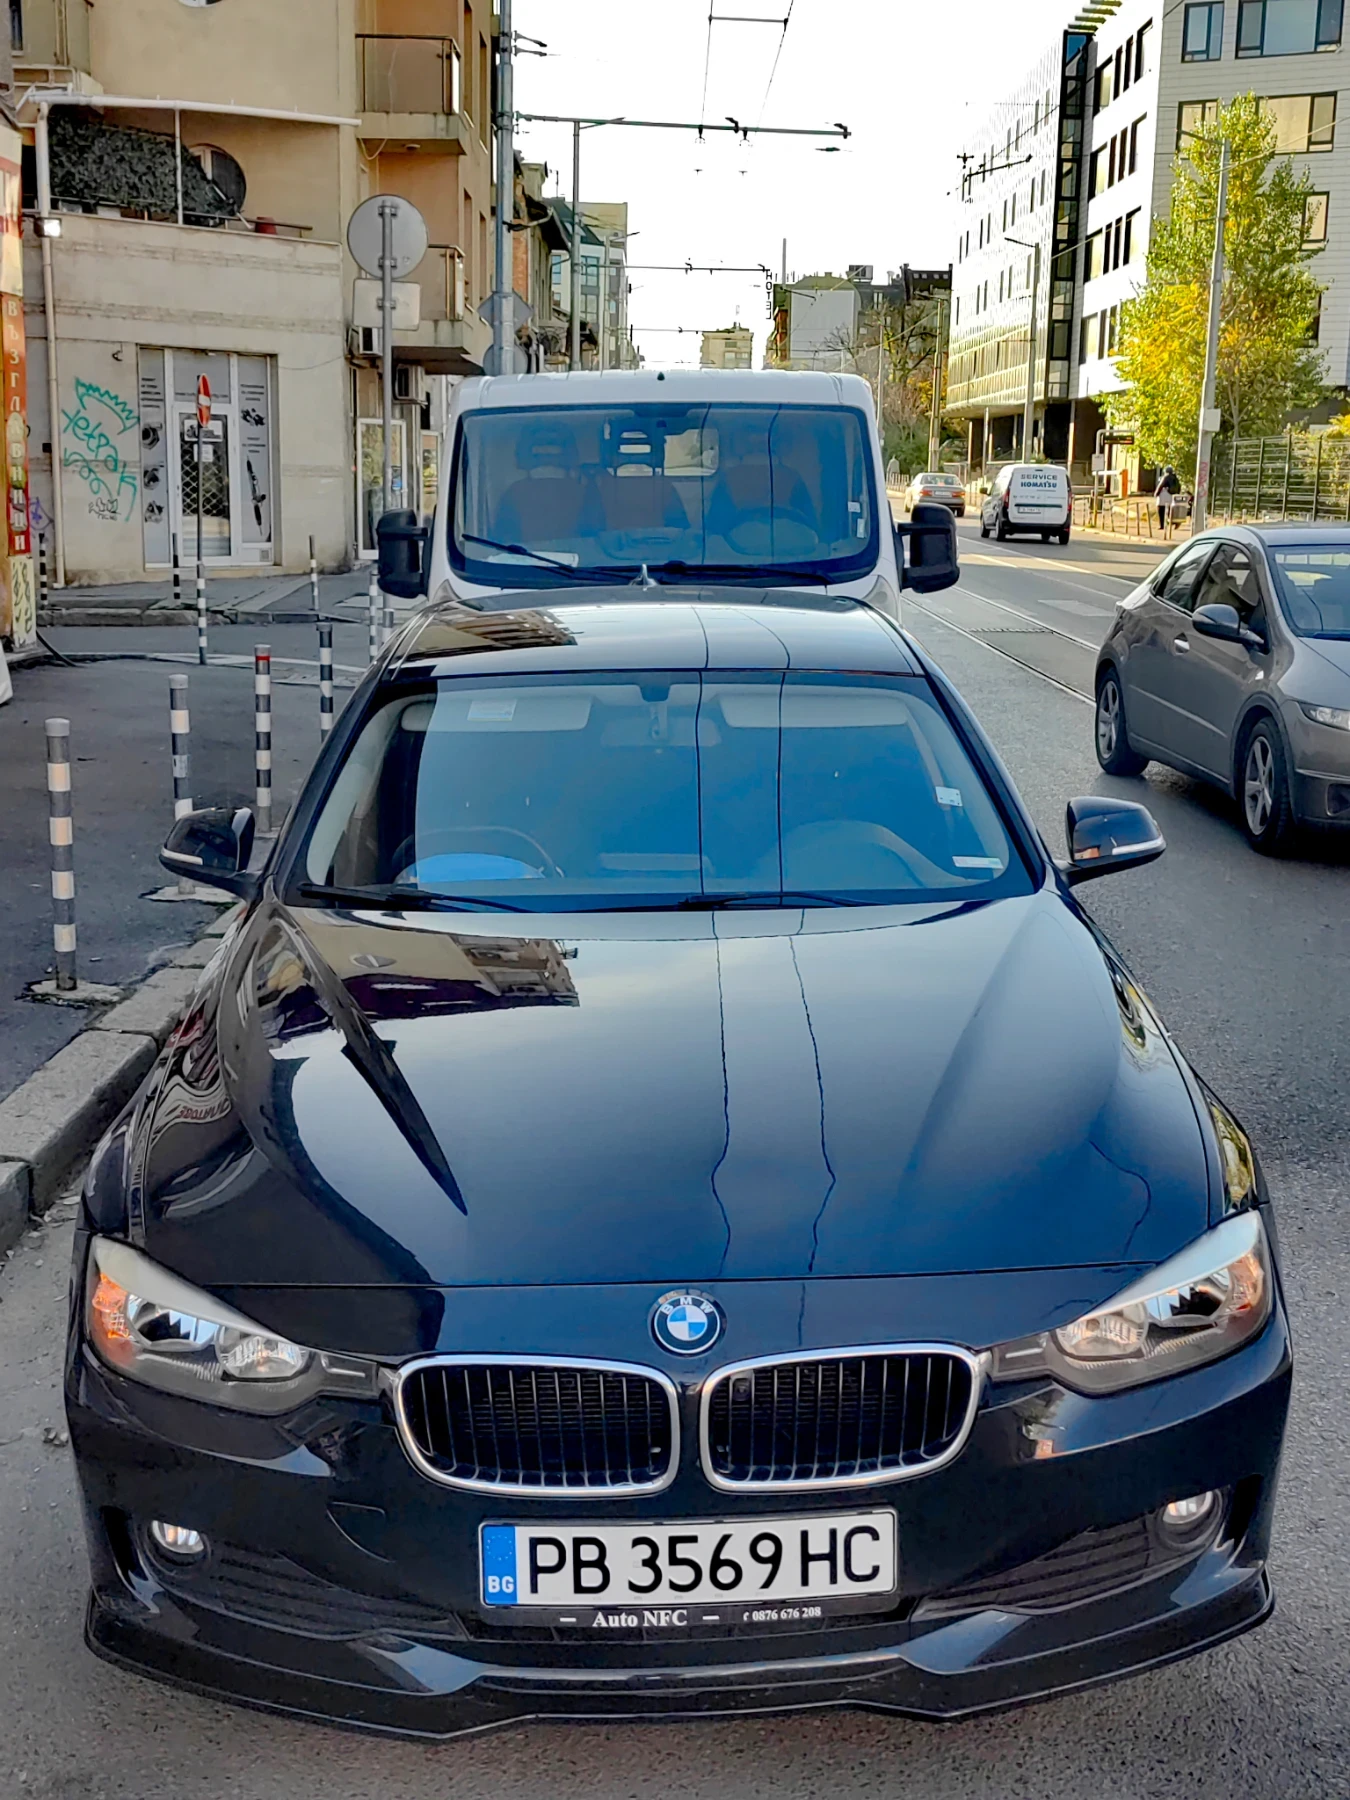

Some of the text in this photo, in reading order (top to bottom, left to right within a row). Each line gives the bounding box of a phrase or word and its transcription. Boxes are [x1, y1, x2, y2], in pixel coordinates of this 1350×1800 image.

[660, 1296, 714, 1315] BMW
[529, 1525, 880, 1594] PB 3569 HC
[488, 1576, 514, 1593] BG
[592, 1610, 687, 1627] Auto NFC
[752, 1606, 821, 1621] 0876 676 208
